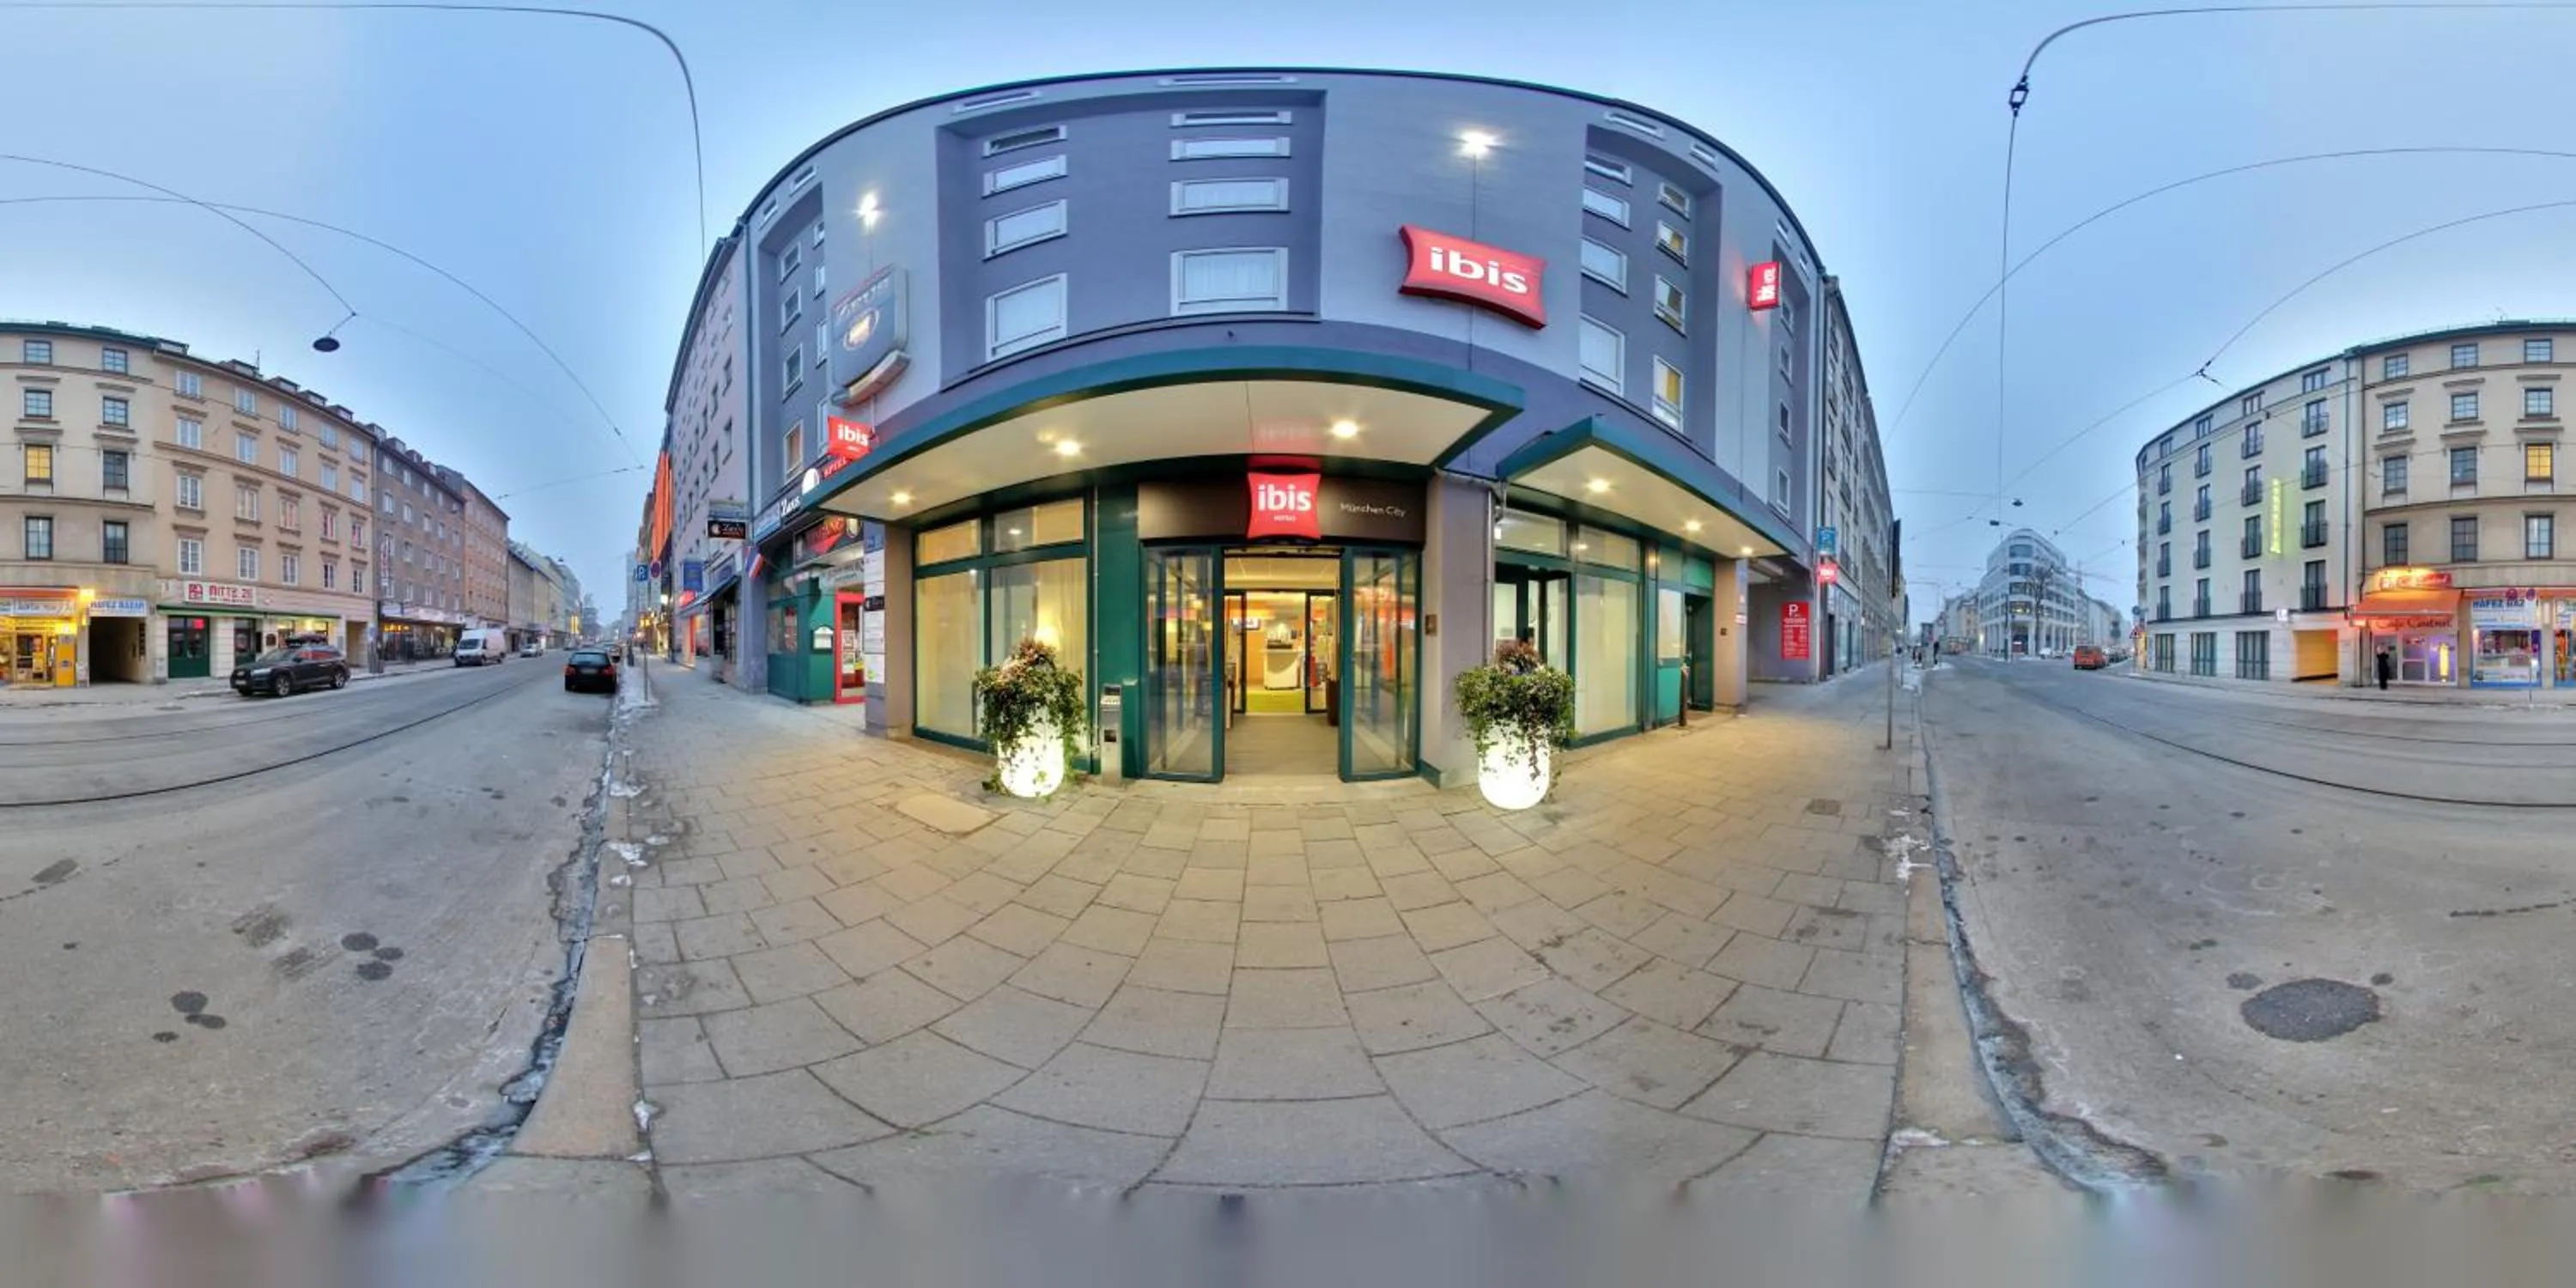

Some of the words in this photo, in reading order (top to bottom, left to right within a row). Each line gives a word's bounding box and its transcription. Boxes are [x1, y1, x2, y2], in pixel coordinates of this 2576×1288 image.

[1431, 246, 1528, 294] ibis
[837, 424, 869, 447] ibis
[1258, 484, 1311, 511] ibis
[1340, 502, 1383, 514] München
[1387, 506, 1407, 517] City
[1789, 604, 1799, 617] P
